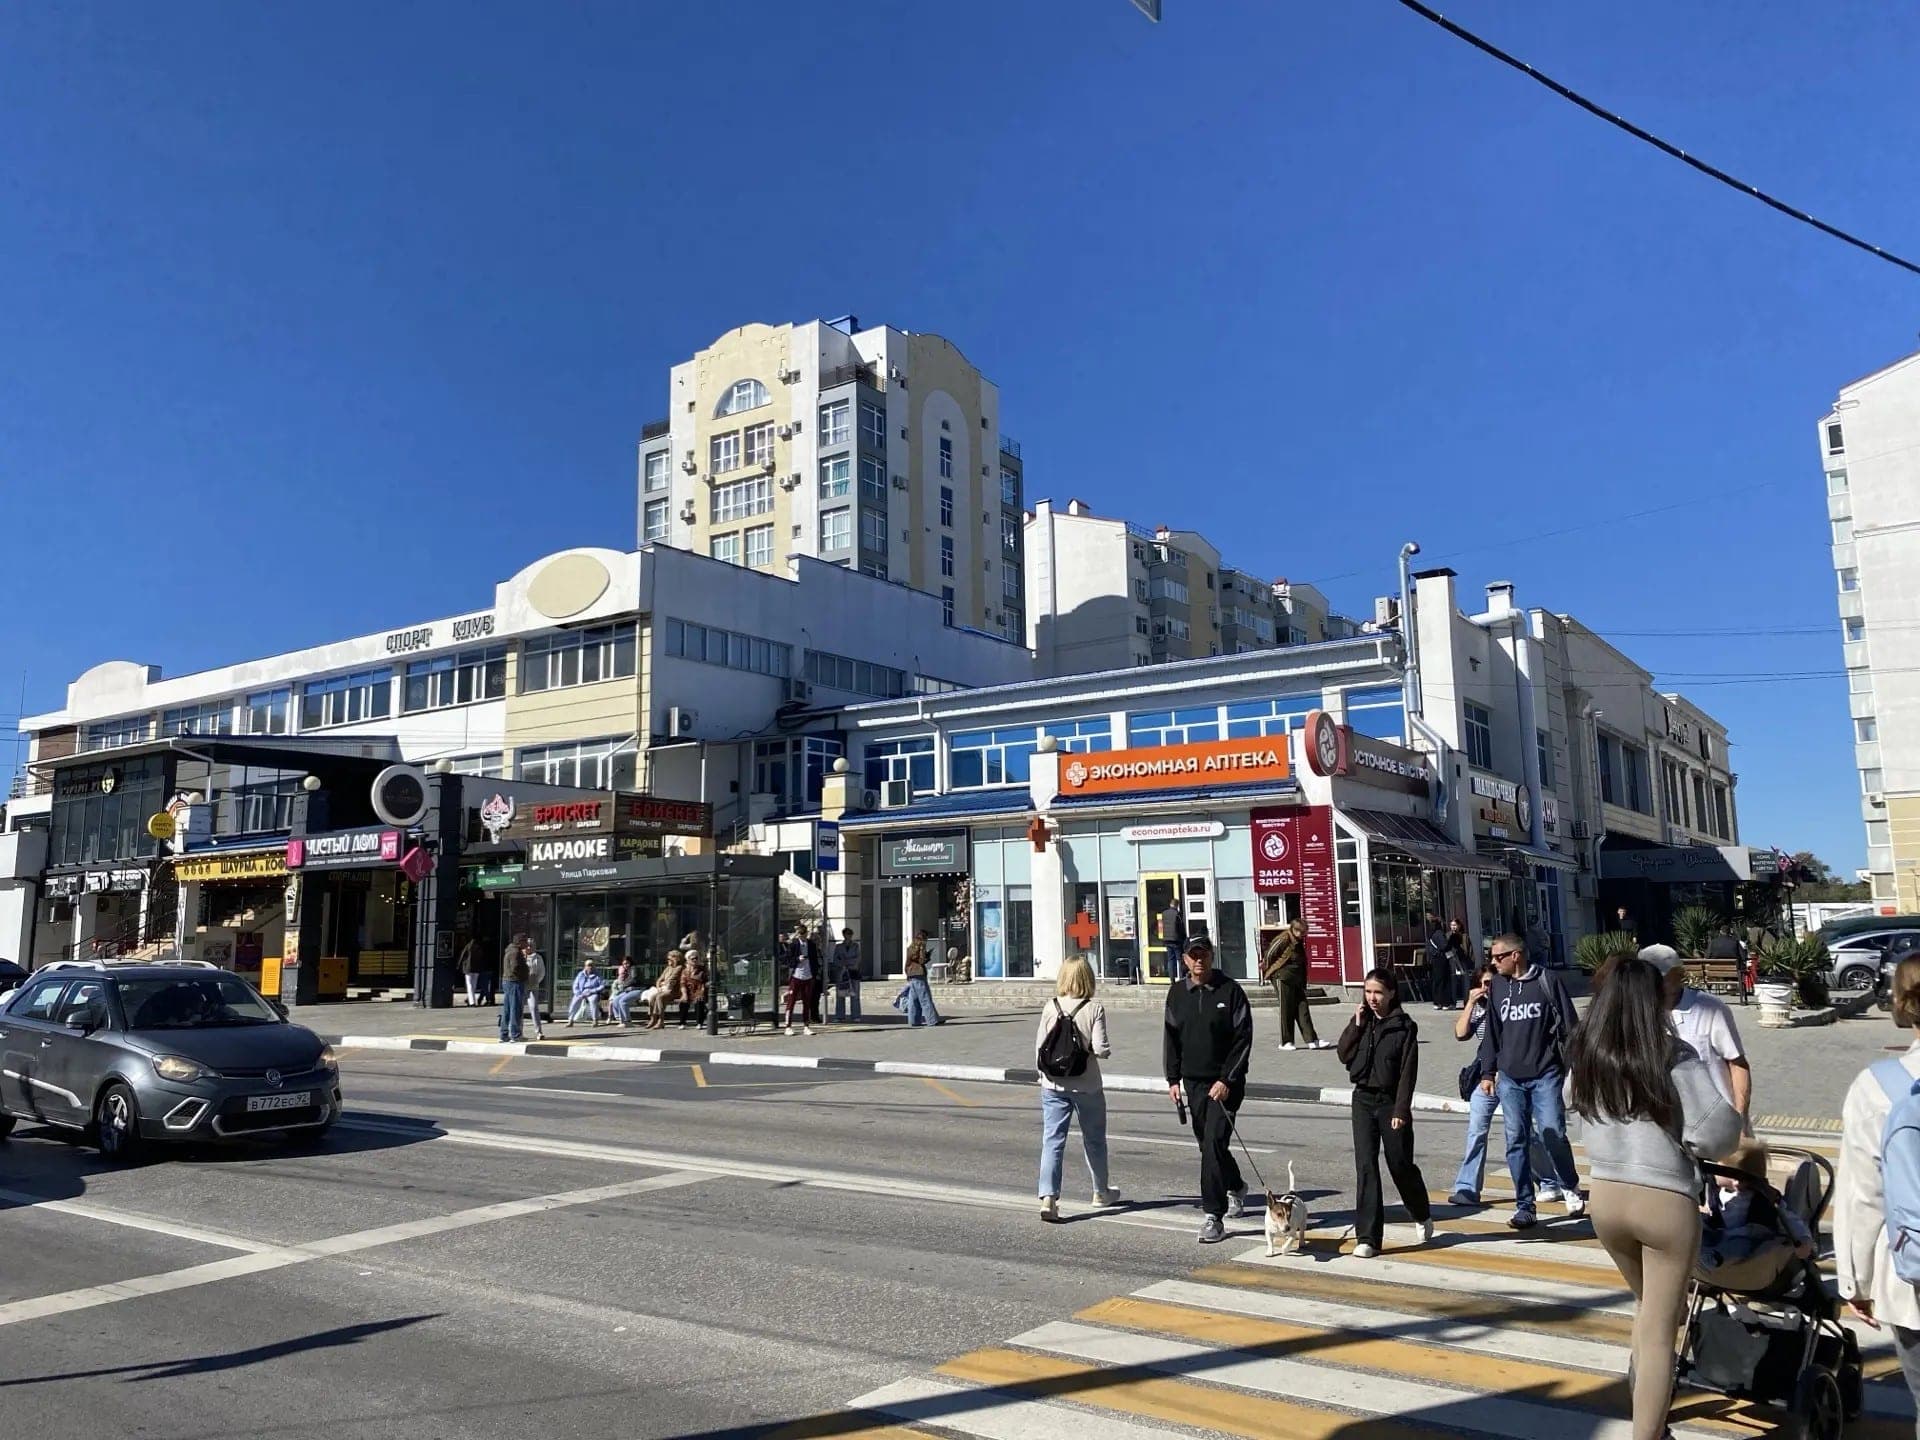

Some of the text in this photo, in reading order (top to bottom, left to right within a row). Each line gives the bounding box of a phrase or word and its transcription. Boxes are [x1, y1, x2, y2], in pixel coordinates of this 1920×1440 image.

[386, 615, 494, 653] СПОРТ КЛУБ
[1090, 750, 1280, 780] ЭКОНОМНАЯ АПТЕКА
[1354, 749, 1397, 773] СТОЧНОЕ
[534, 802, 600, 823] БРИСКЕТ
[631, 801, 701, 820] БРИСКЕТ
[1131, 825, 1211, 837] economapteka.ru
[306, 833, 379, 855] ЧИСТЫЙ ДОМ
[532, 839, 608, 861] КАРАОКЕ
[620, 838, 659, 849] КАРАОКЕ
[221, 859, 257, 874] ШАУРМА
[265, 857, 285, 871] КОФ
[560, 868, 617, 879] Улица Парковая
[1259, 869, 1293, 877] ЗАКАЗ
[1258, 878, 1295, 886] ЗДЕСЬ
[1508, 1002, 1541, 1021] asics
